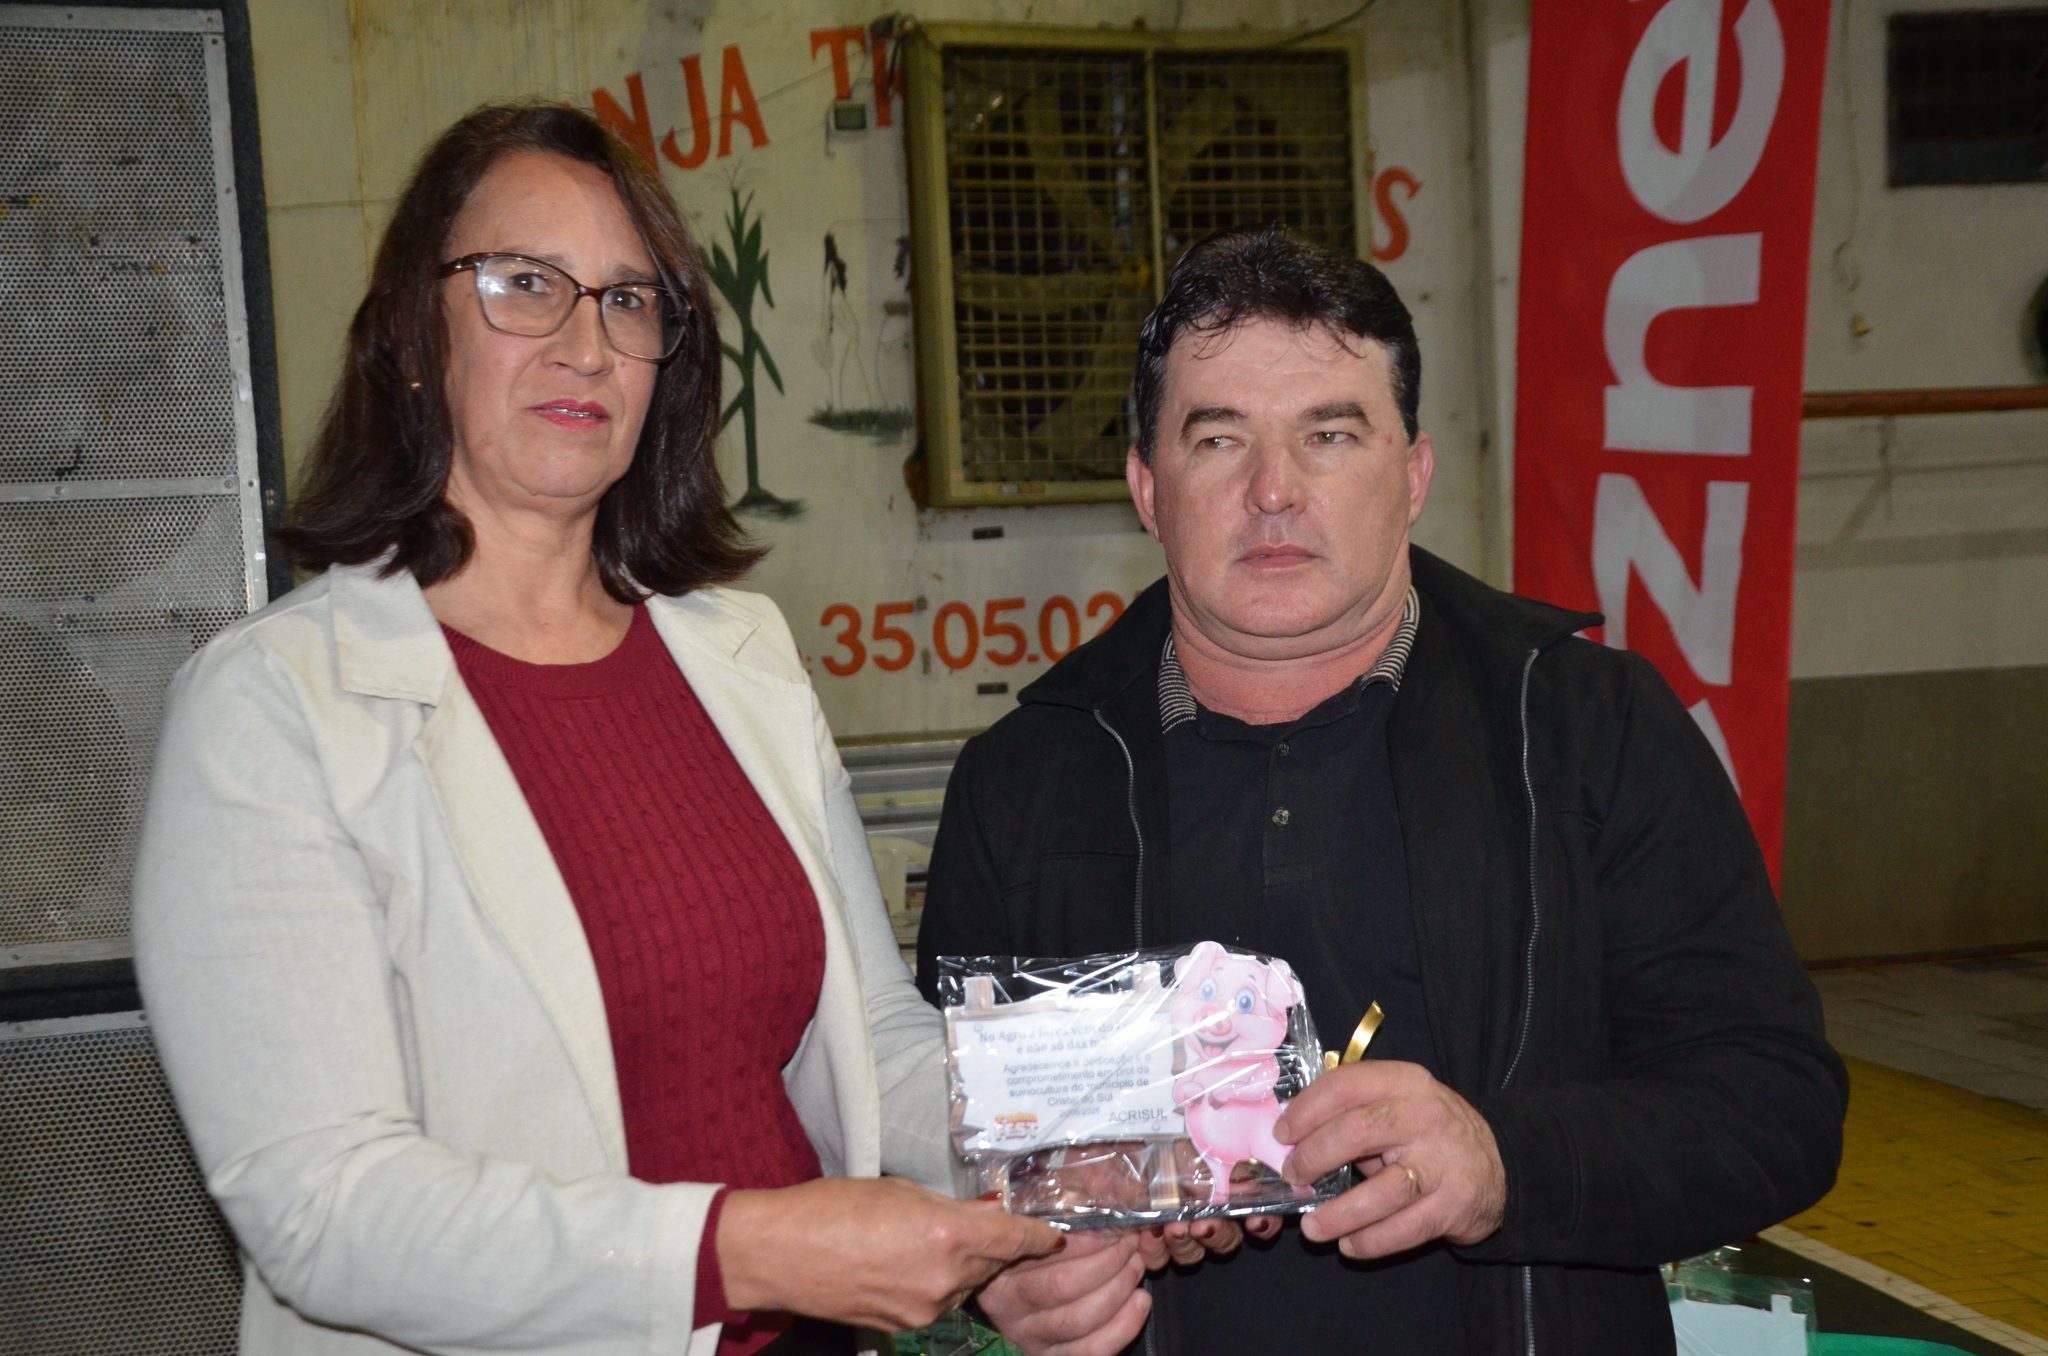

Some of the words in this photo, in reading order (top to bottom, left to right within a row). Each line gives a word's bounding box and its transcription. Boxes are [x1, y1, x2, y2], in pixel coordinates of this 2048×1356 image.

[562, 42, 770, 186] NJA
[979, 1032, 996, 1043] No
[999, 1030, 1026, 1043] Agro
[1007, 1070, 1095, 1086] comprometimento
[1137, 1066, 1149, 1074] da
[1009, 1085, 1069, 1098] suinocultura
[1137, 1078, 1149, 1087] de
[1097, 1093, 1113, 1102] Sul
[1108, 1108, 1168, 1122] ACRISUL
